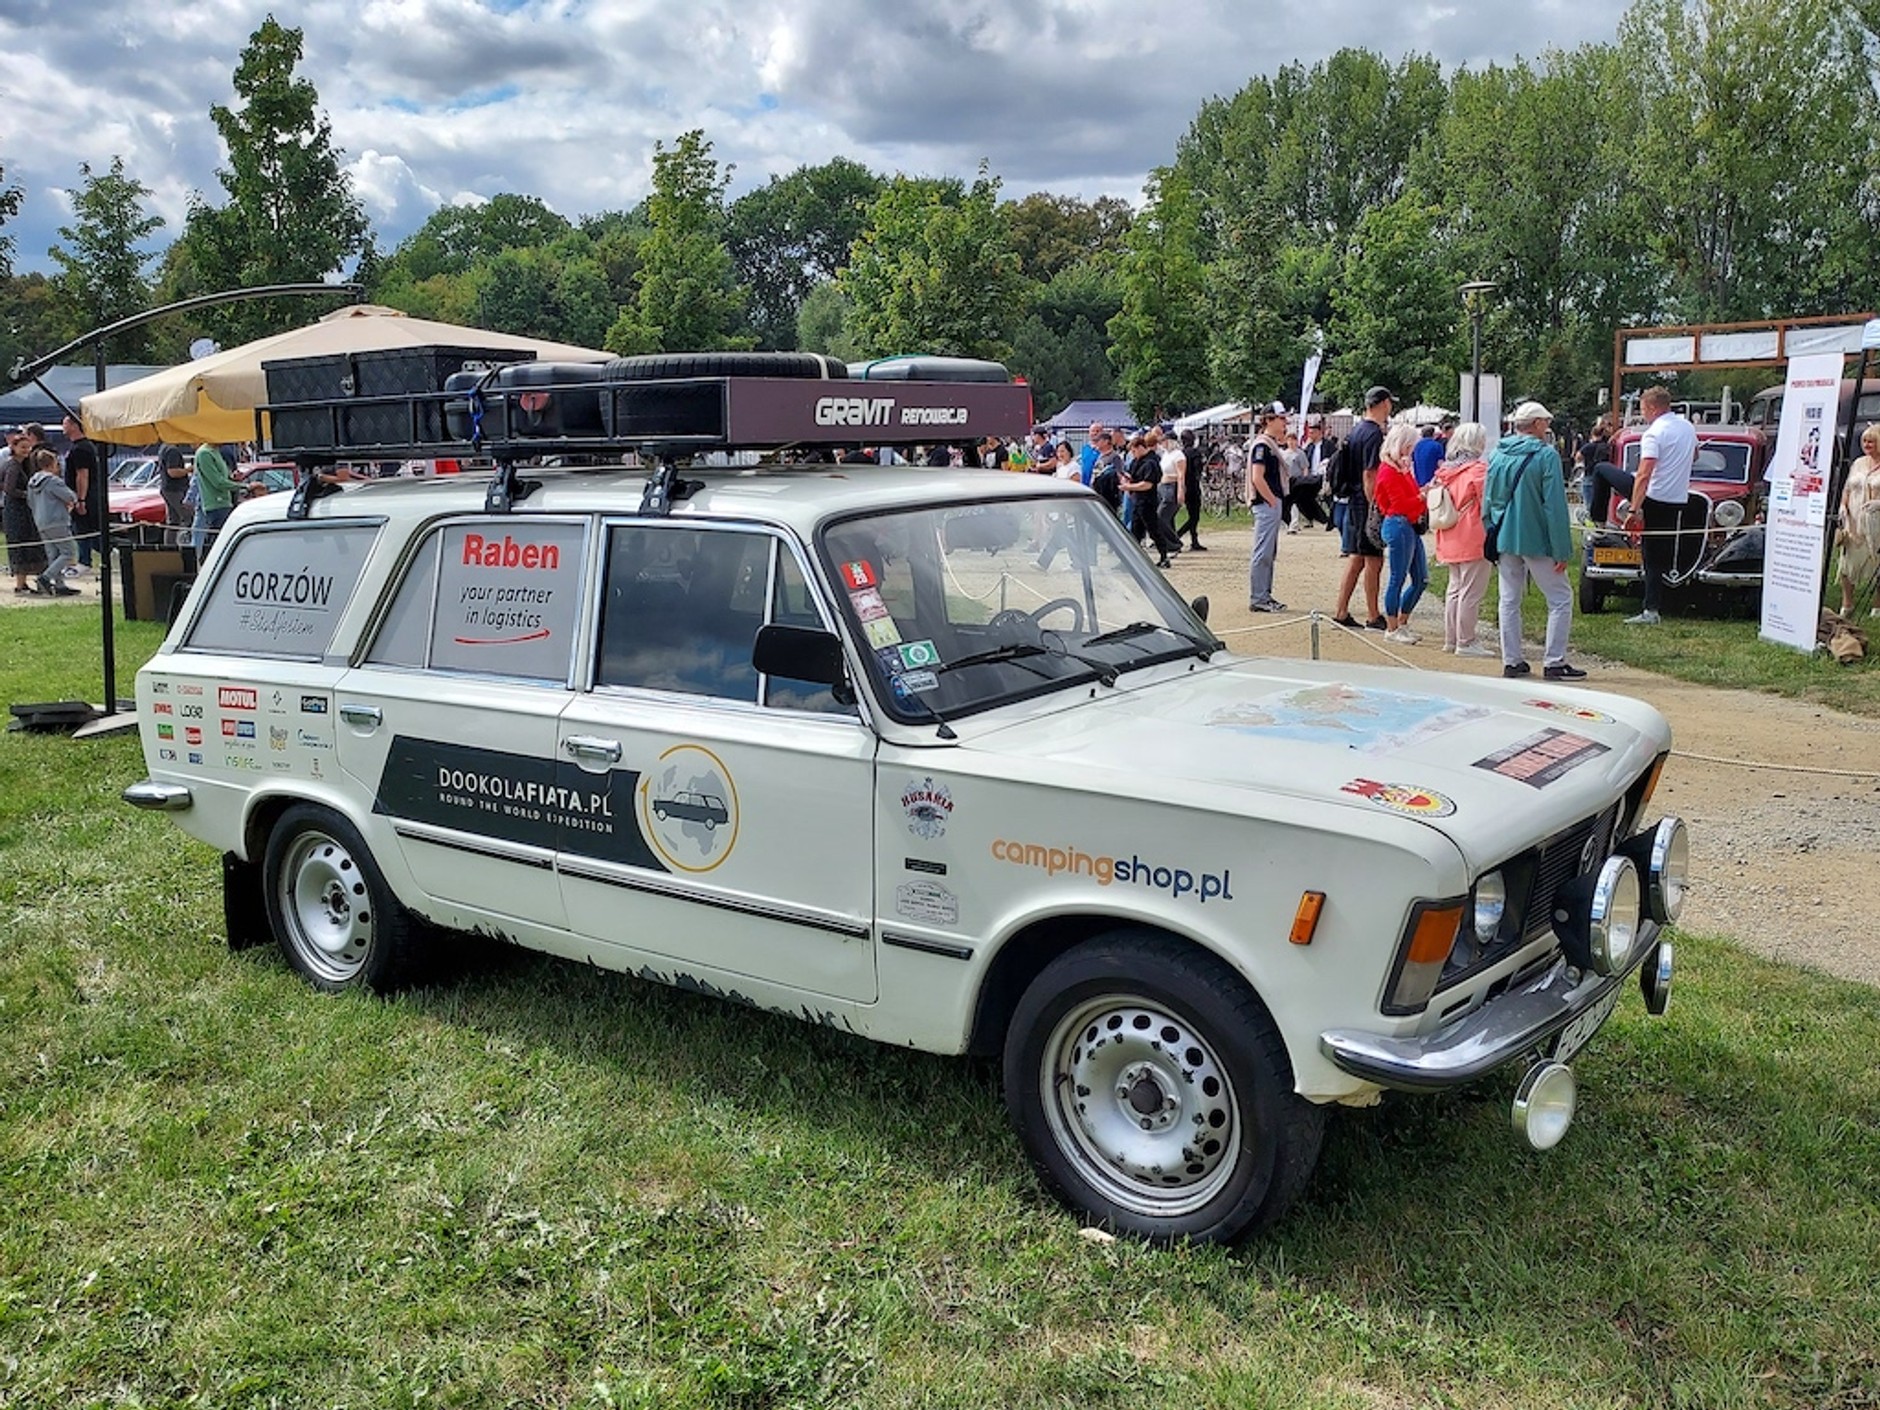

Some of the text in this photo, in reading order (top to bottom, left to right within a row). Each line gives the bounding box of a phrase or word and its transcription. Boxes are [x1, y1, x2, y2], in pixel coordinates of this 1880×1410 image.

[461, 534, 560, 571] Raben
[235, 566, 334, 605] GORZÓW
[460, 584, 553, 606] your partner
[465, 606, 542, 630] in logistics
[220, 690, 256, 708] MOTUL
[439, 767, 613, 817] DOOKOLAFIATA.PL
[439, 792, 474, 807] ROUND
[479, 800, 498, 812] THE
[503, 805, 541, 820] WORLD
[991, 838, 1233, 903] campingshop.pl
